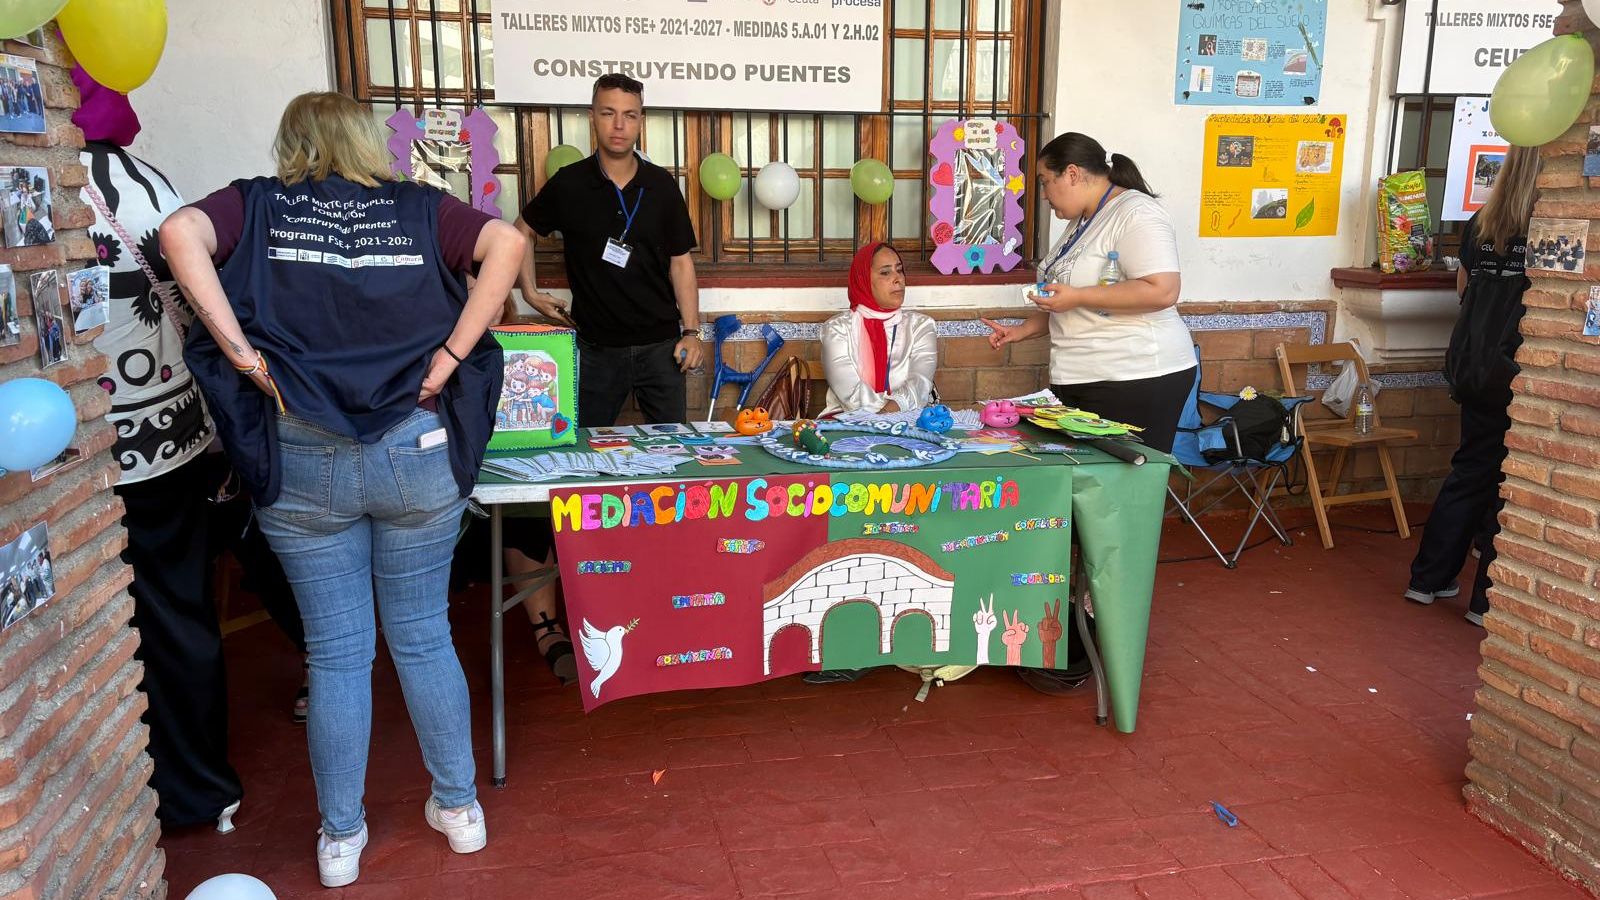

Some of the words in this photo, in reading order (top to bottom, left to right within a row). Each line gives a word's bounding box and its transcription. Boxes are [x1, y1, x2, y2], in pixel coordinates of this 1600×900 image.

[501, 12, 567, 32] TALLERES
[572, 14, 621, 33] MIXTOS
[626, 16, 656, 35] FSE+
[660, 18, 722, 37] 2021-2027
[734, 20, 788, 38] MEDIDAS
[791, 22, 827, 39] 5.A.01
[831, 23, 839, 40] Y
[843, 24, 879, 41] 2.H.02
[1486, 12, 1530, 28] MIXTOS
[533, 58, 736, 81] CONSTRUYENDO
[745, 64, 851, 83] PUENTES
[275, 193, 309, 206] TALLER
[356, 197, 394, 211] EMPLEO
[269, 228, 324, 243] Programa
[354, 236, 413, 249] 2021-2027
[552, 481, 738, 532] MEDIACIÓN
[745, 475, 1019, 521] SOCIOCOMUNITARIA
